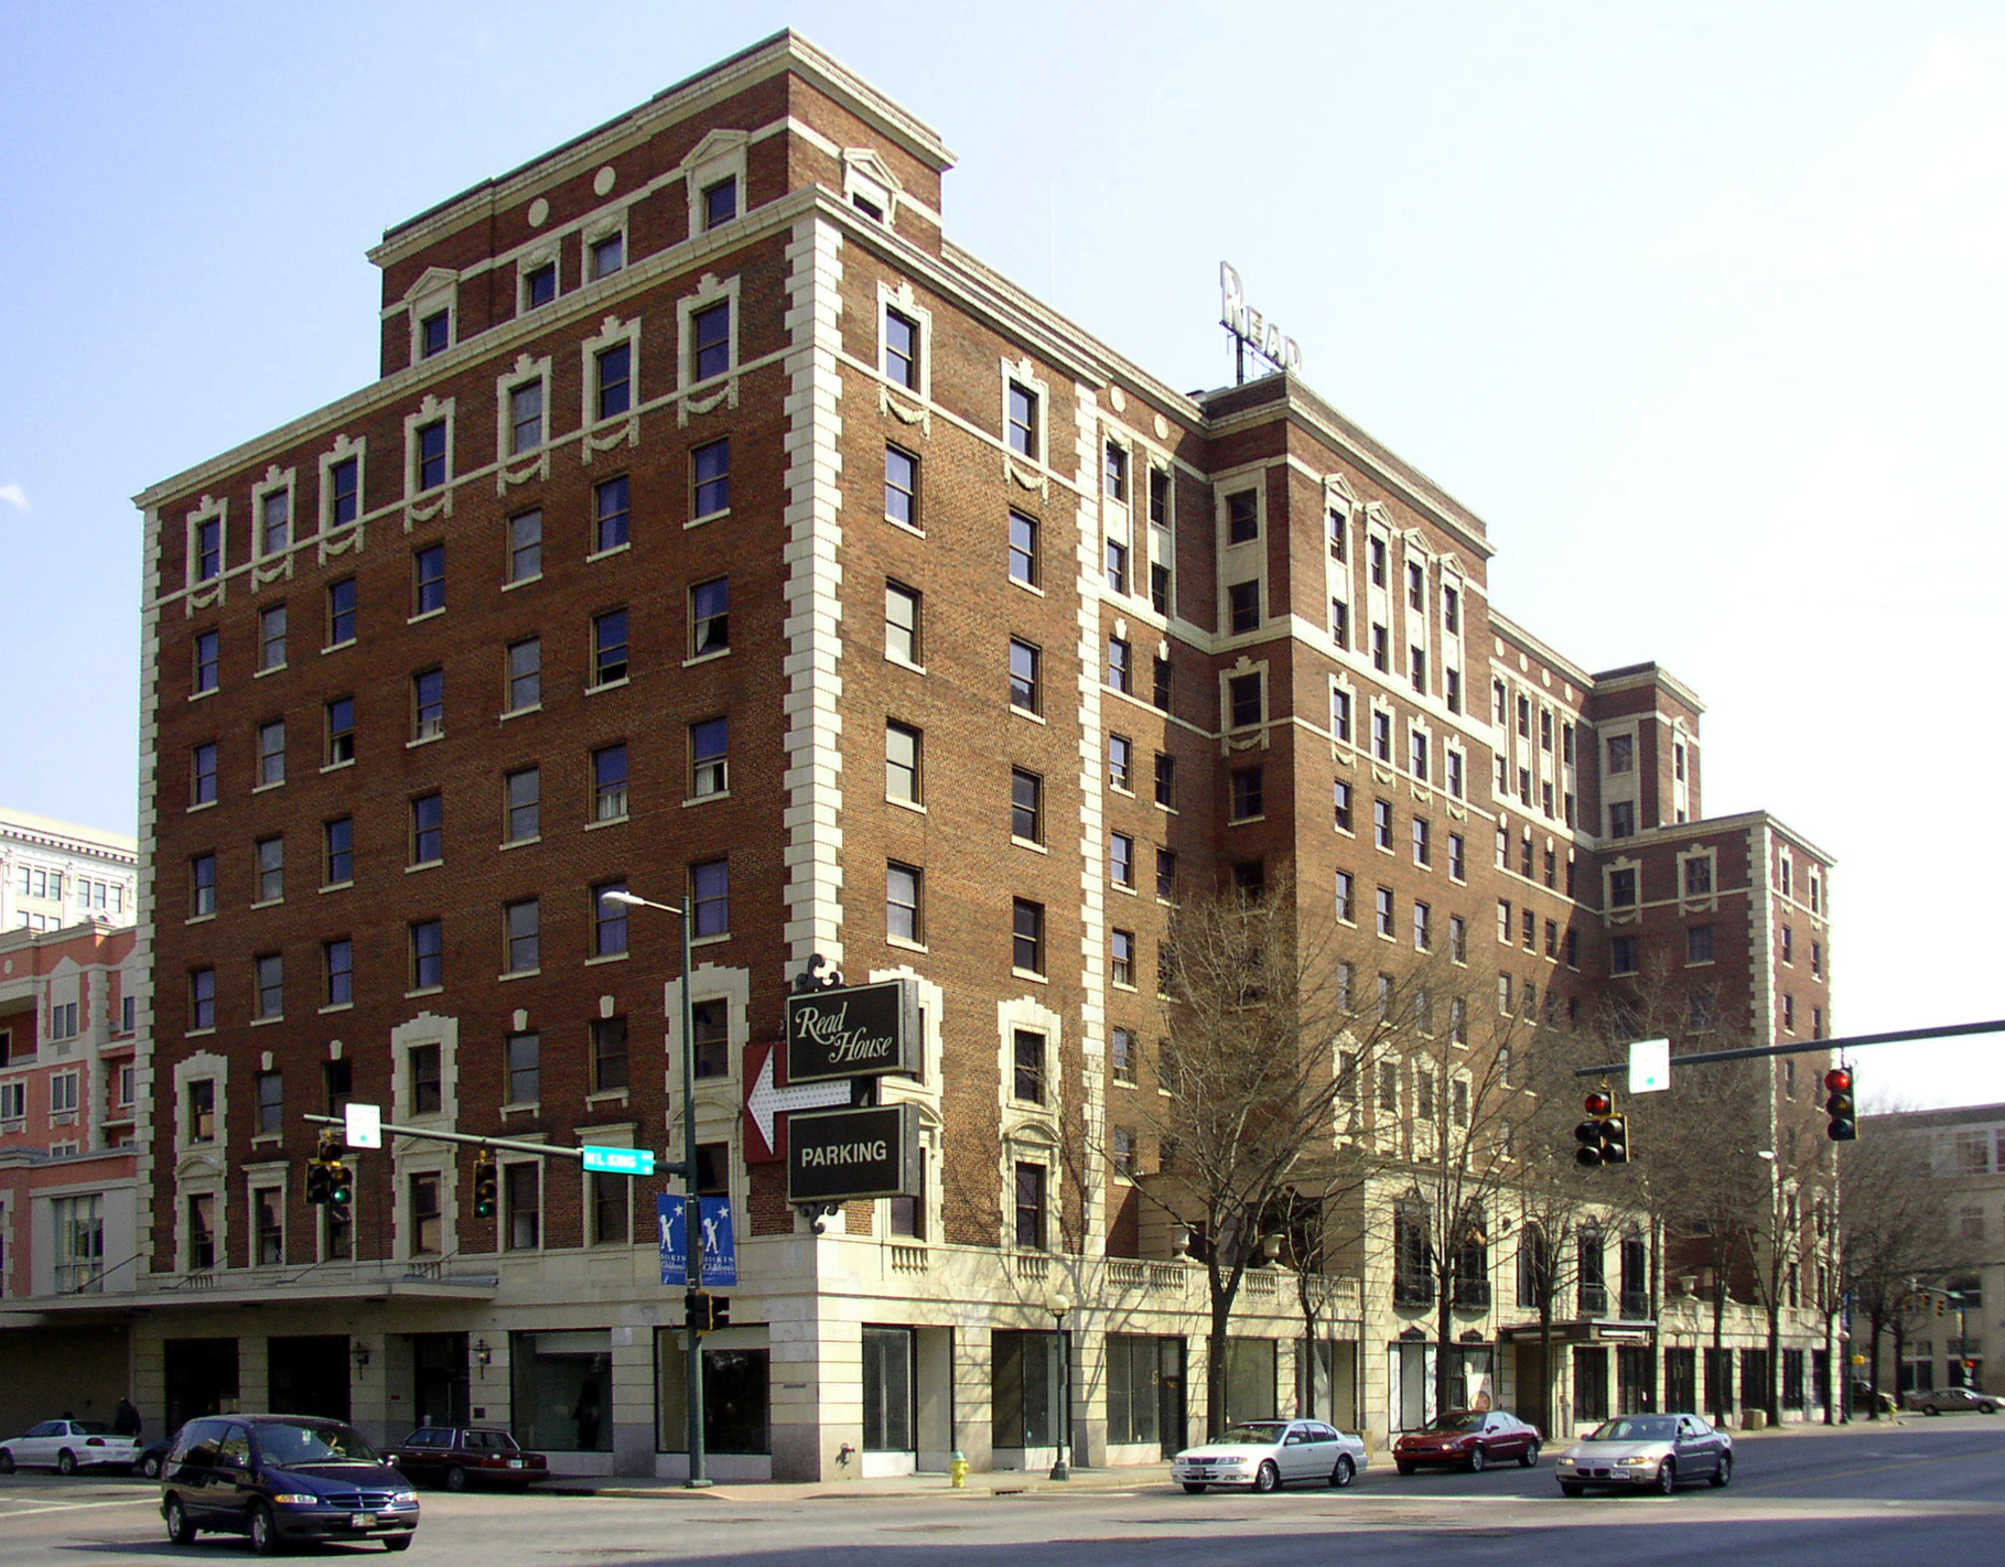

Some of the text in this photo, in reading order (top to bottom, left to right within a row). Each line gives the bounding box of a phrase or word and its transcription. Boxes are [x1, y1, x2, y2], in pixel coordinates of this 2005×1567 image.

[1220, 260, 1302, 372] READ
[795, 1001, 848, 1045] Read
[828, 1027, 893, 1063] House
[801, 1140, 887, 1168] PARKING
